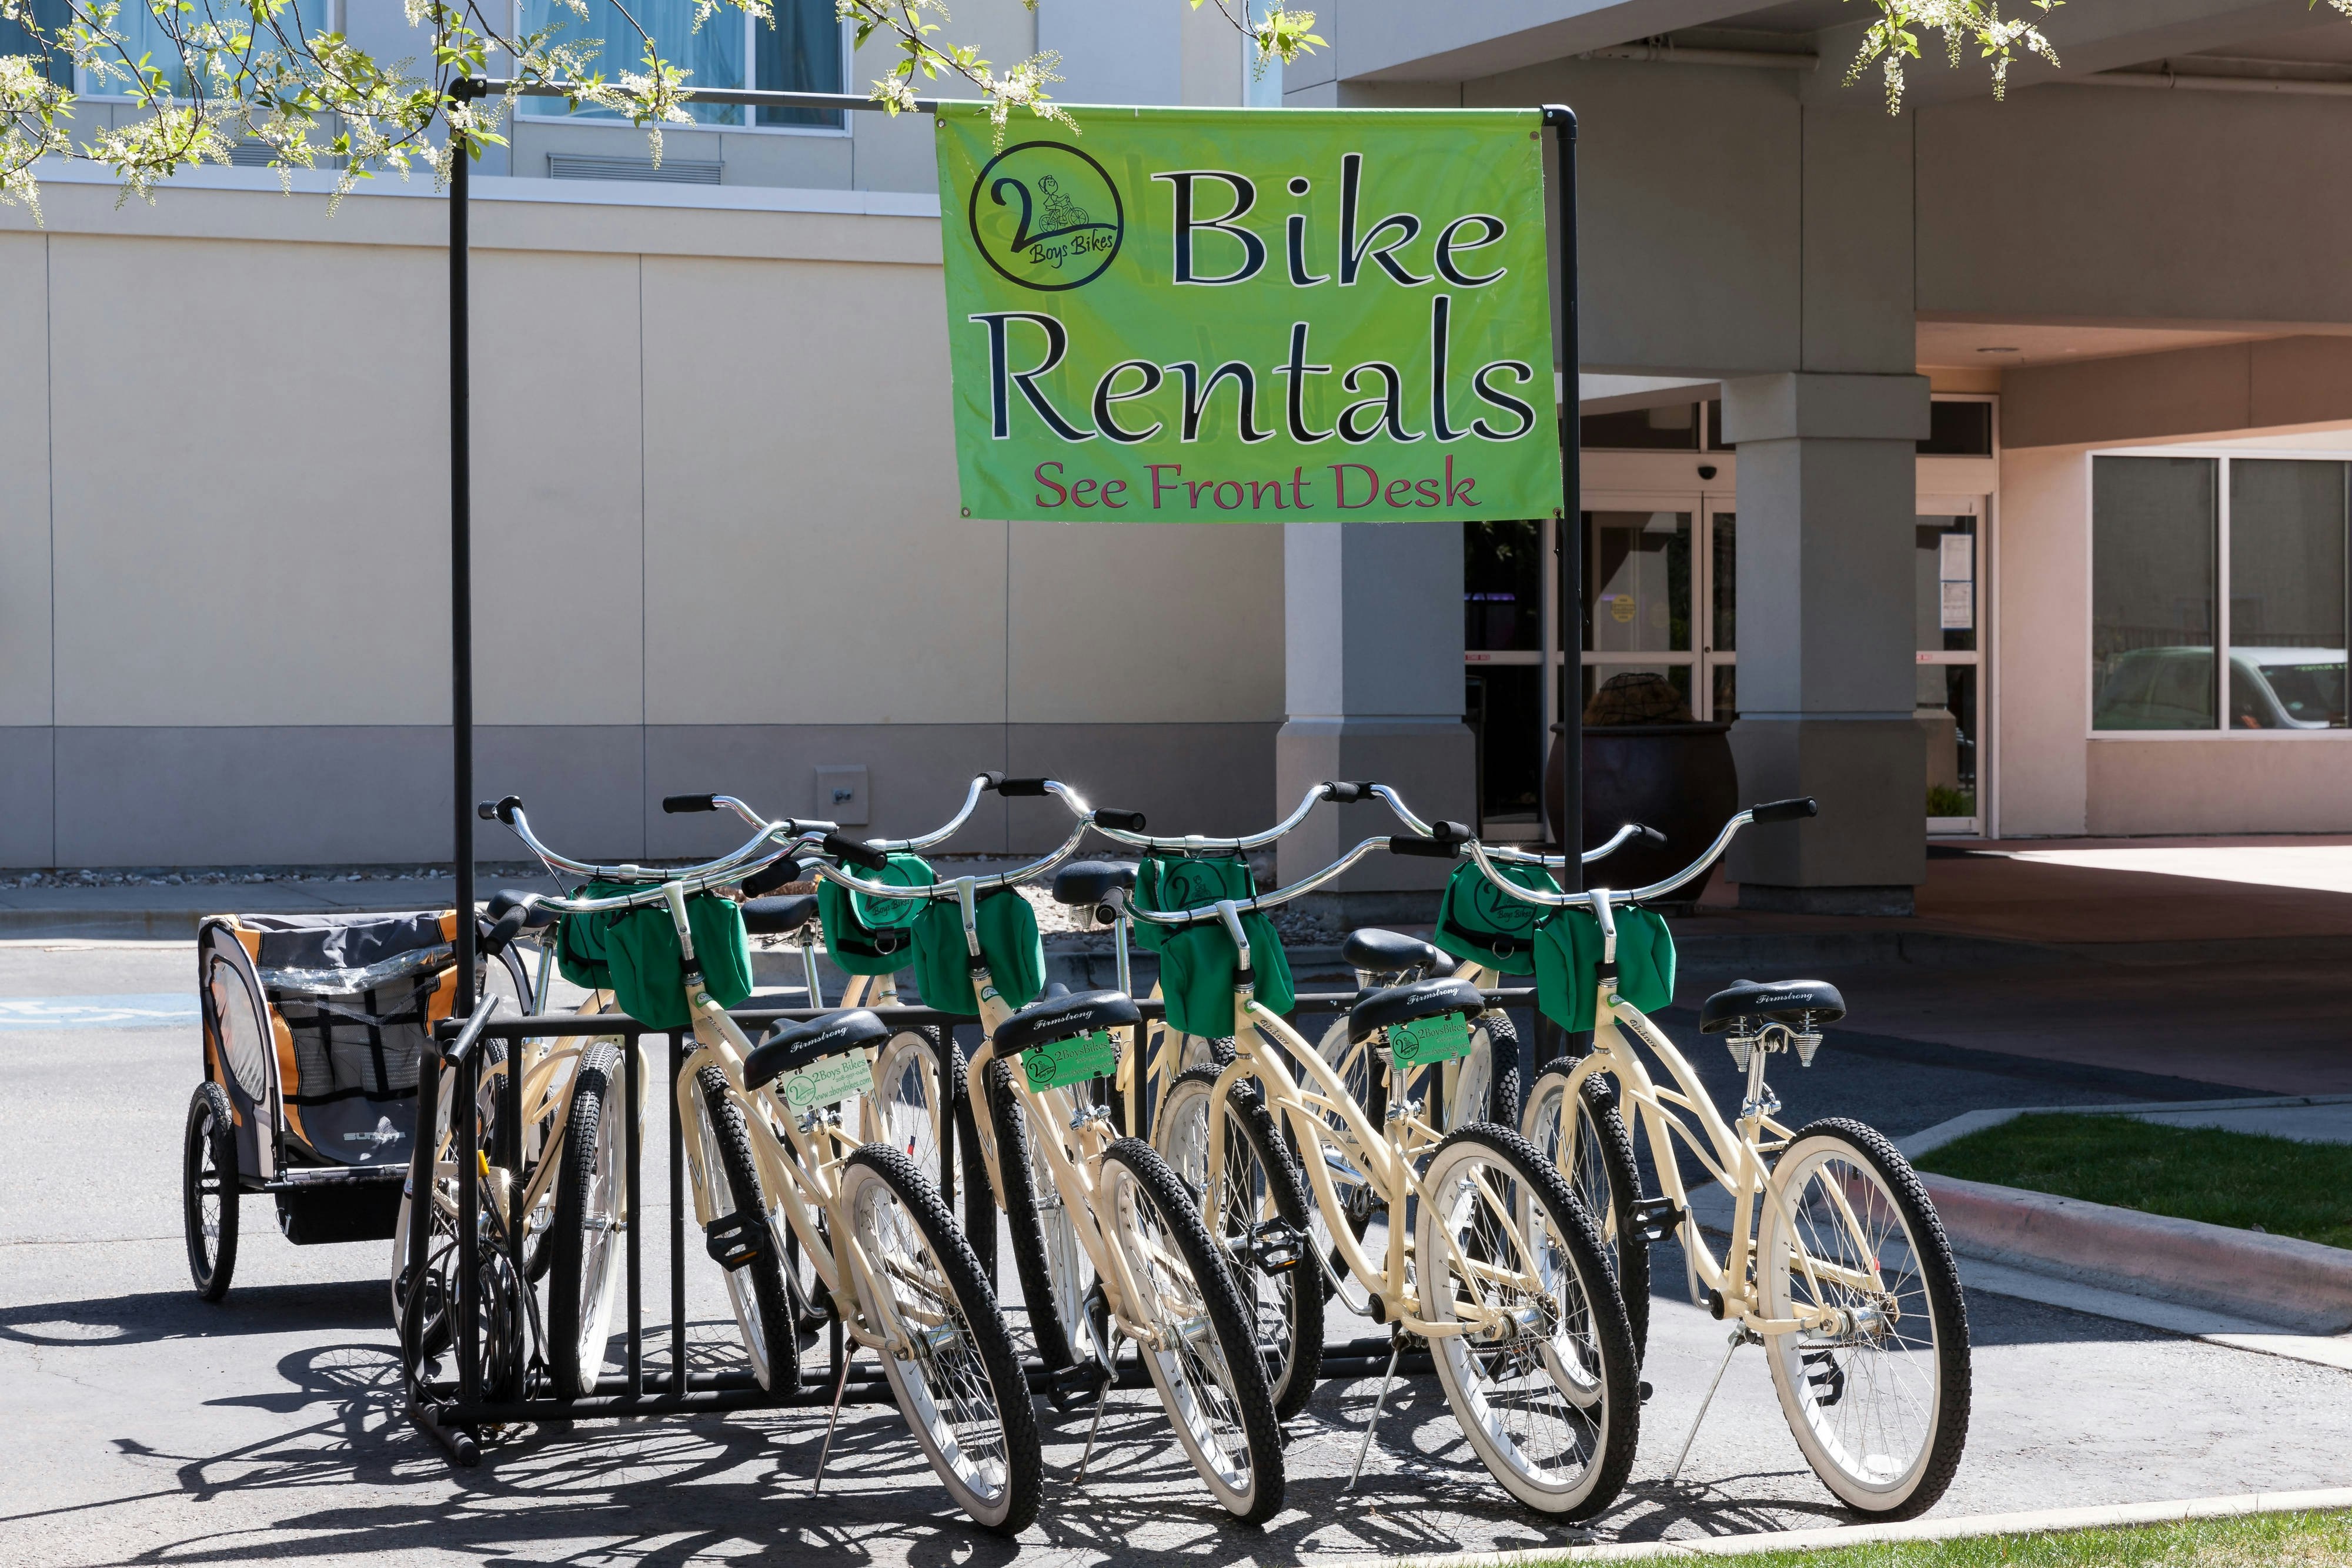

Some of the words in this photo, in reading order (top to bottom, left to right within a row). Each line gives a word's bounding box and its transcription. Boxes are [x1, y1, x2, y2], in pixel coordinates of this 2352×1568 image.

[991, 178, 1117, 253] 2
[1150, 152, 1509, 288] Bike
[1029, 244, 1068, 269] Boys
[1071, 229, 1112, 255] Bikes
[968, 294, 1536, 445] Rentals
[1034, 462, 1128, 509] See
[1144, 464, 1312, 510] Front
[1328, 454, 1482, 510] Desk
[1406, 988, 1459, 1005] Firmstrong
[1756, 992, 1815, 1004] Firmstrong
[1033, 1011, 1095, 1030] Firmstrong
[790, 1026, 849, 1053] Firmstrong
[812, 1067, 841, 1083] 2Boys
[841, 1059, 866, 1073] Bikes
[814, 1076, 872, 1101] www.2boysbikes.com
